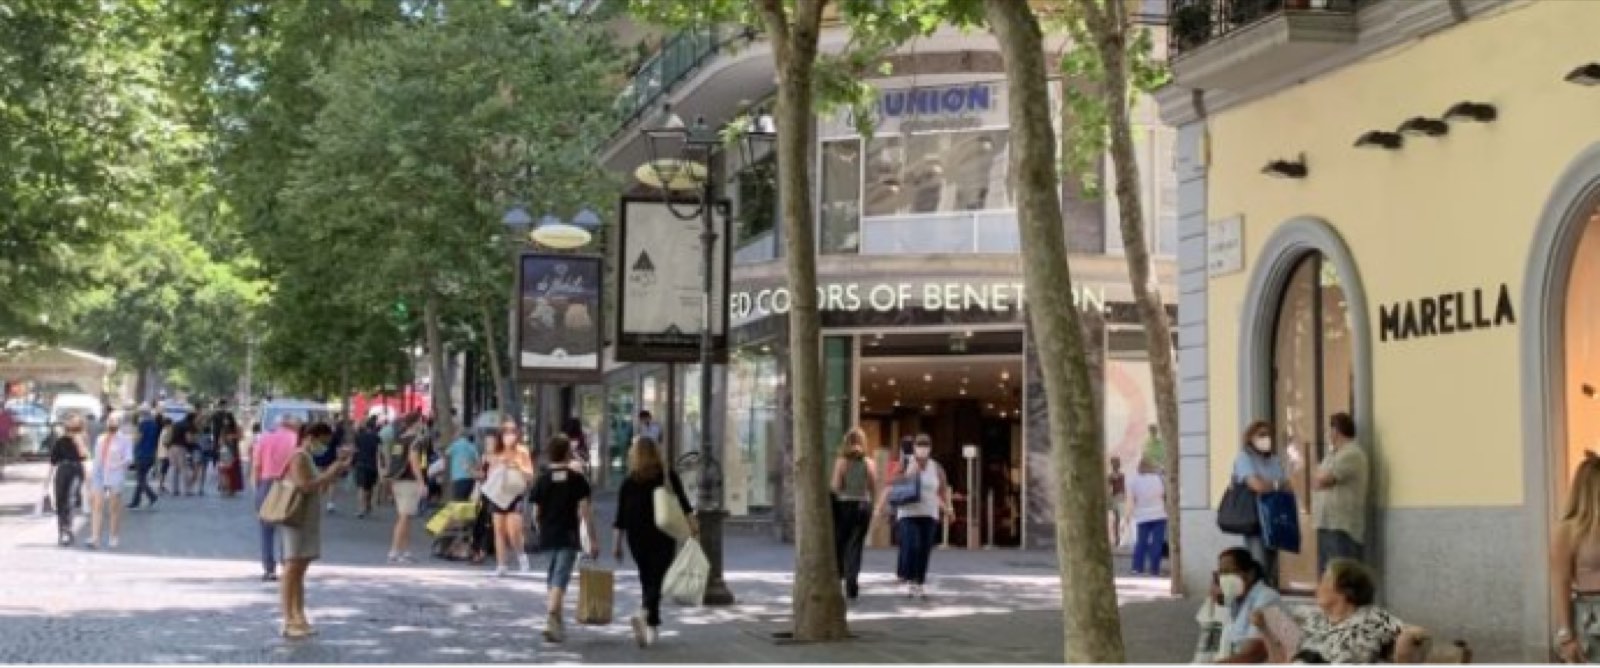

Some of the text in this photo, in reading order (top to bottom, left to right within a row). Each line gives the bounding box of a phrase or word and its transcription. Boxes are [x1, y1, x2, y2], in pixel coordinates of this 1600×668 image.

[884, 85, 989, 117] UNION
[757, 284, 861, 314] CORS
[869, 283, 912, 312] OF
[921, 282, 1112, 313] BENETN.
[1379, 282, 1516, 343] MARELLA
